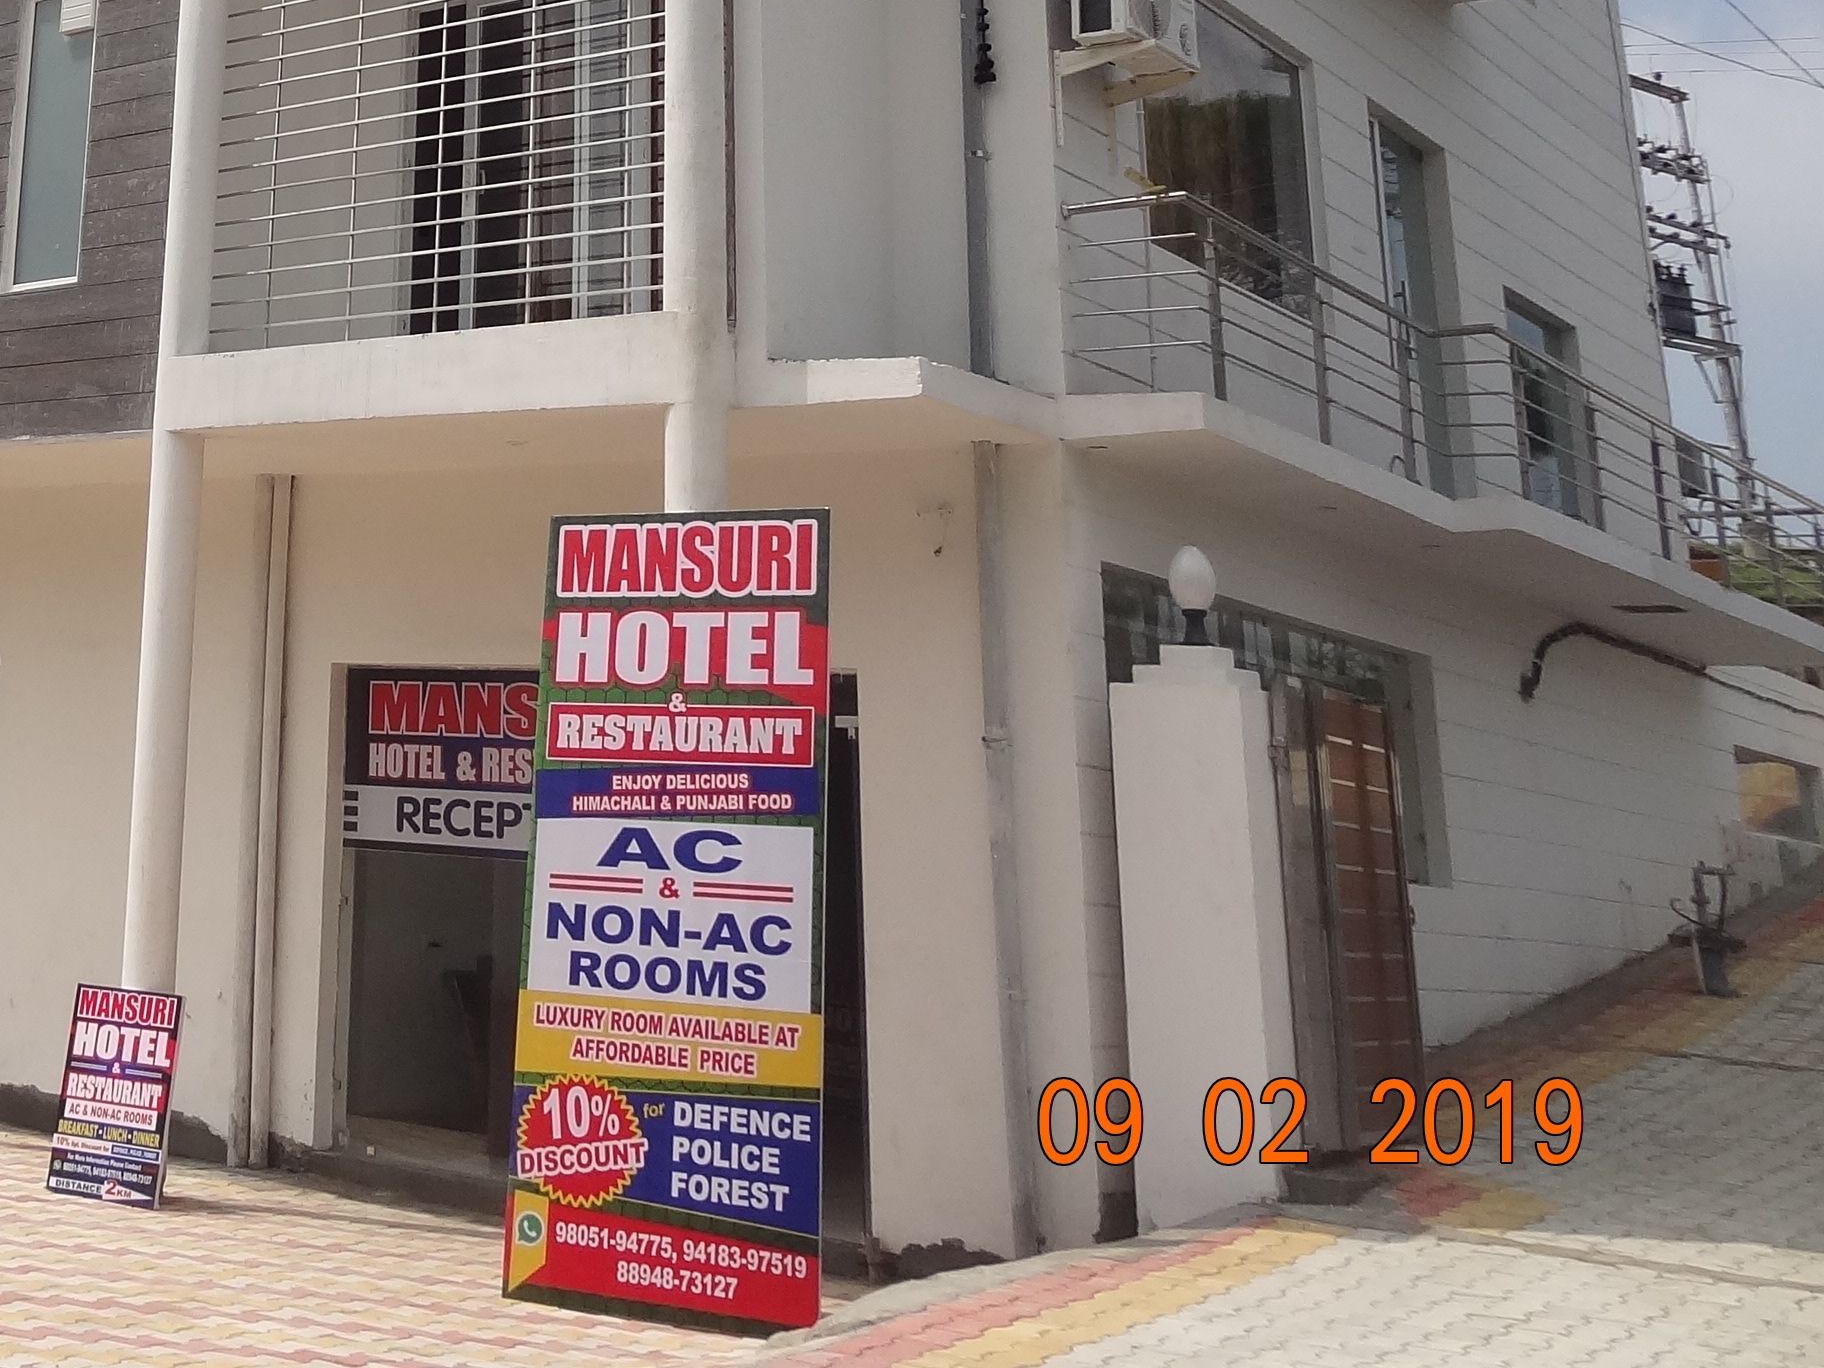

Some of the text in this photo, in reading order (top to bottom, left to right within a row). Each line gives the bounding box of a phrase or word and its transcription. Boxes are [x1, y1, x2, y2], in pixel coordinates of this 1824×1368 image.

[556, 519, 818, 598] MANSURI
[555, 610, 815, 685] HOTEL
[369, 680, 539, 740] MANS
[668, 692, 687, 712] &
[556, 713, 803, 755] RESTAURANT
[368, 743, 535, 784] HOTEL & RES
[612, 773, 749, 790] ENJOY DELICIOUS
[396, 796, 531, 839] RECEP
[572, 794, 792, 811] HIMACHALI & PUNJABI FOOD
[596, 826, 743, 874] AC
[659, 877, 680, 899] &
[545, 901, 793, 956] NON-AC
[568, 950, 767, 1002] ROOMS
[77, 987, 178, 1028] MANSURI
[535, 1004, 606, 1030] LUXURY
[610, 1011, 663, 1036] ROOM
[667, 1016, 769, 1046] AVAILABLE
[774, 1025, 800, 1048] AT
[72, 1021, 171, 1067] HOTEL
[572, 1037, 755, 1075] AFFORDABLE PRICE
[112, 1062, 121, 1074] &
[66, 1072, 163, 1109] RESTAURANT
[69, 1102, 153, 1126] AC & NON-AC ROOMS
[542, 1085, 620, 1140] 10%
[643, 1100, 812, 1142] for DEFENCE
[57, 1136, 70, 1147] 10%
[58, 1119, 160, 1148] BREAKFAST LUNCH DINNER
[516, 1138, 649, 1179] DISCOUNT
[672, 1135, 781, 1174] POLICE
[55, 1179, 102, 1194] DISTANCE
[670, 1171, 790, 1212] FOREST
[555, 1220, 808, 1279] 98051-94775, 94183-97519
[616, 1260, 738, 1300] 88948-73127
